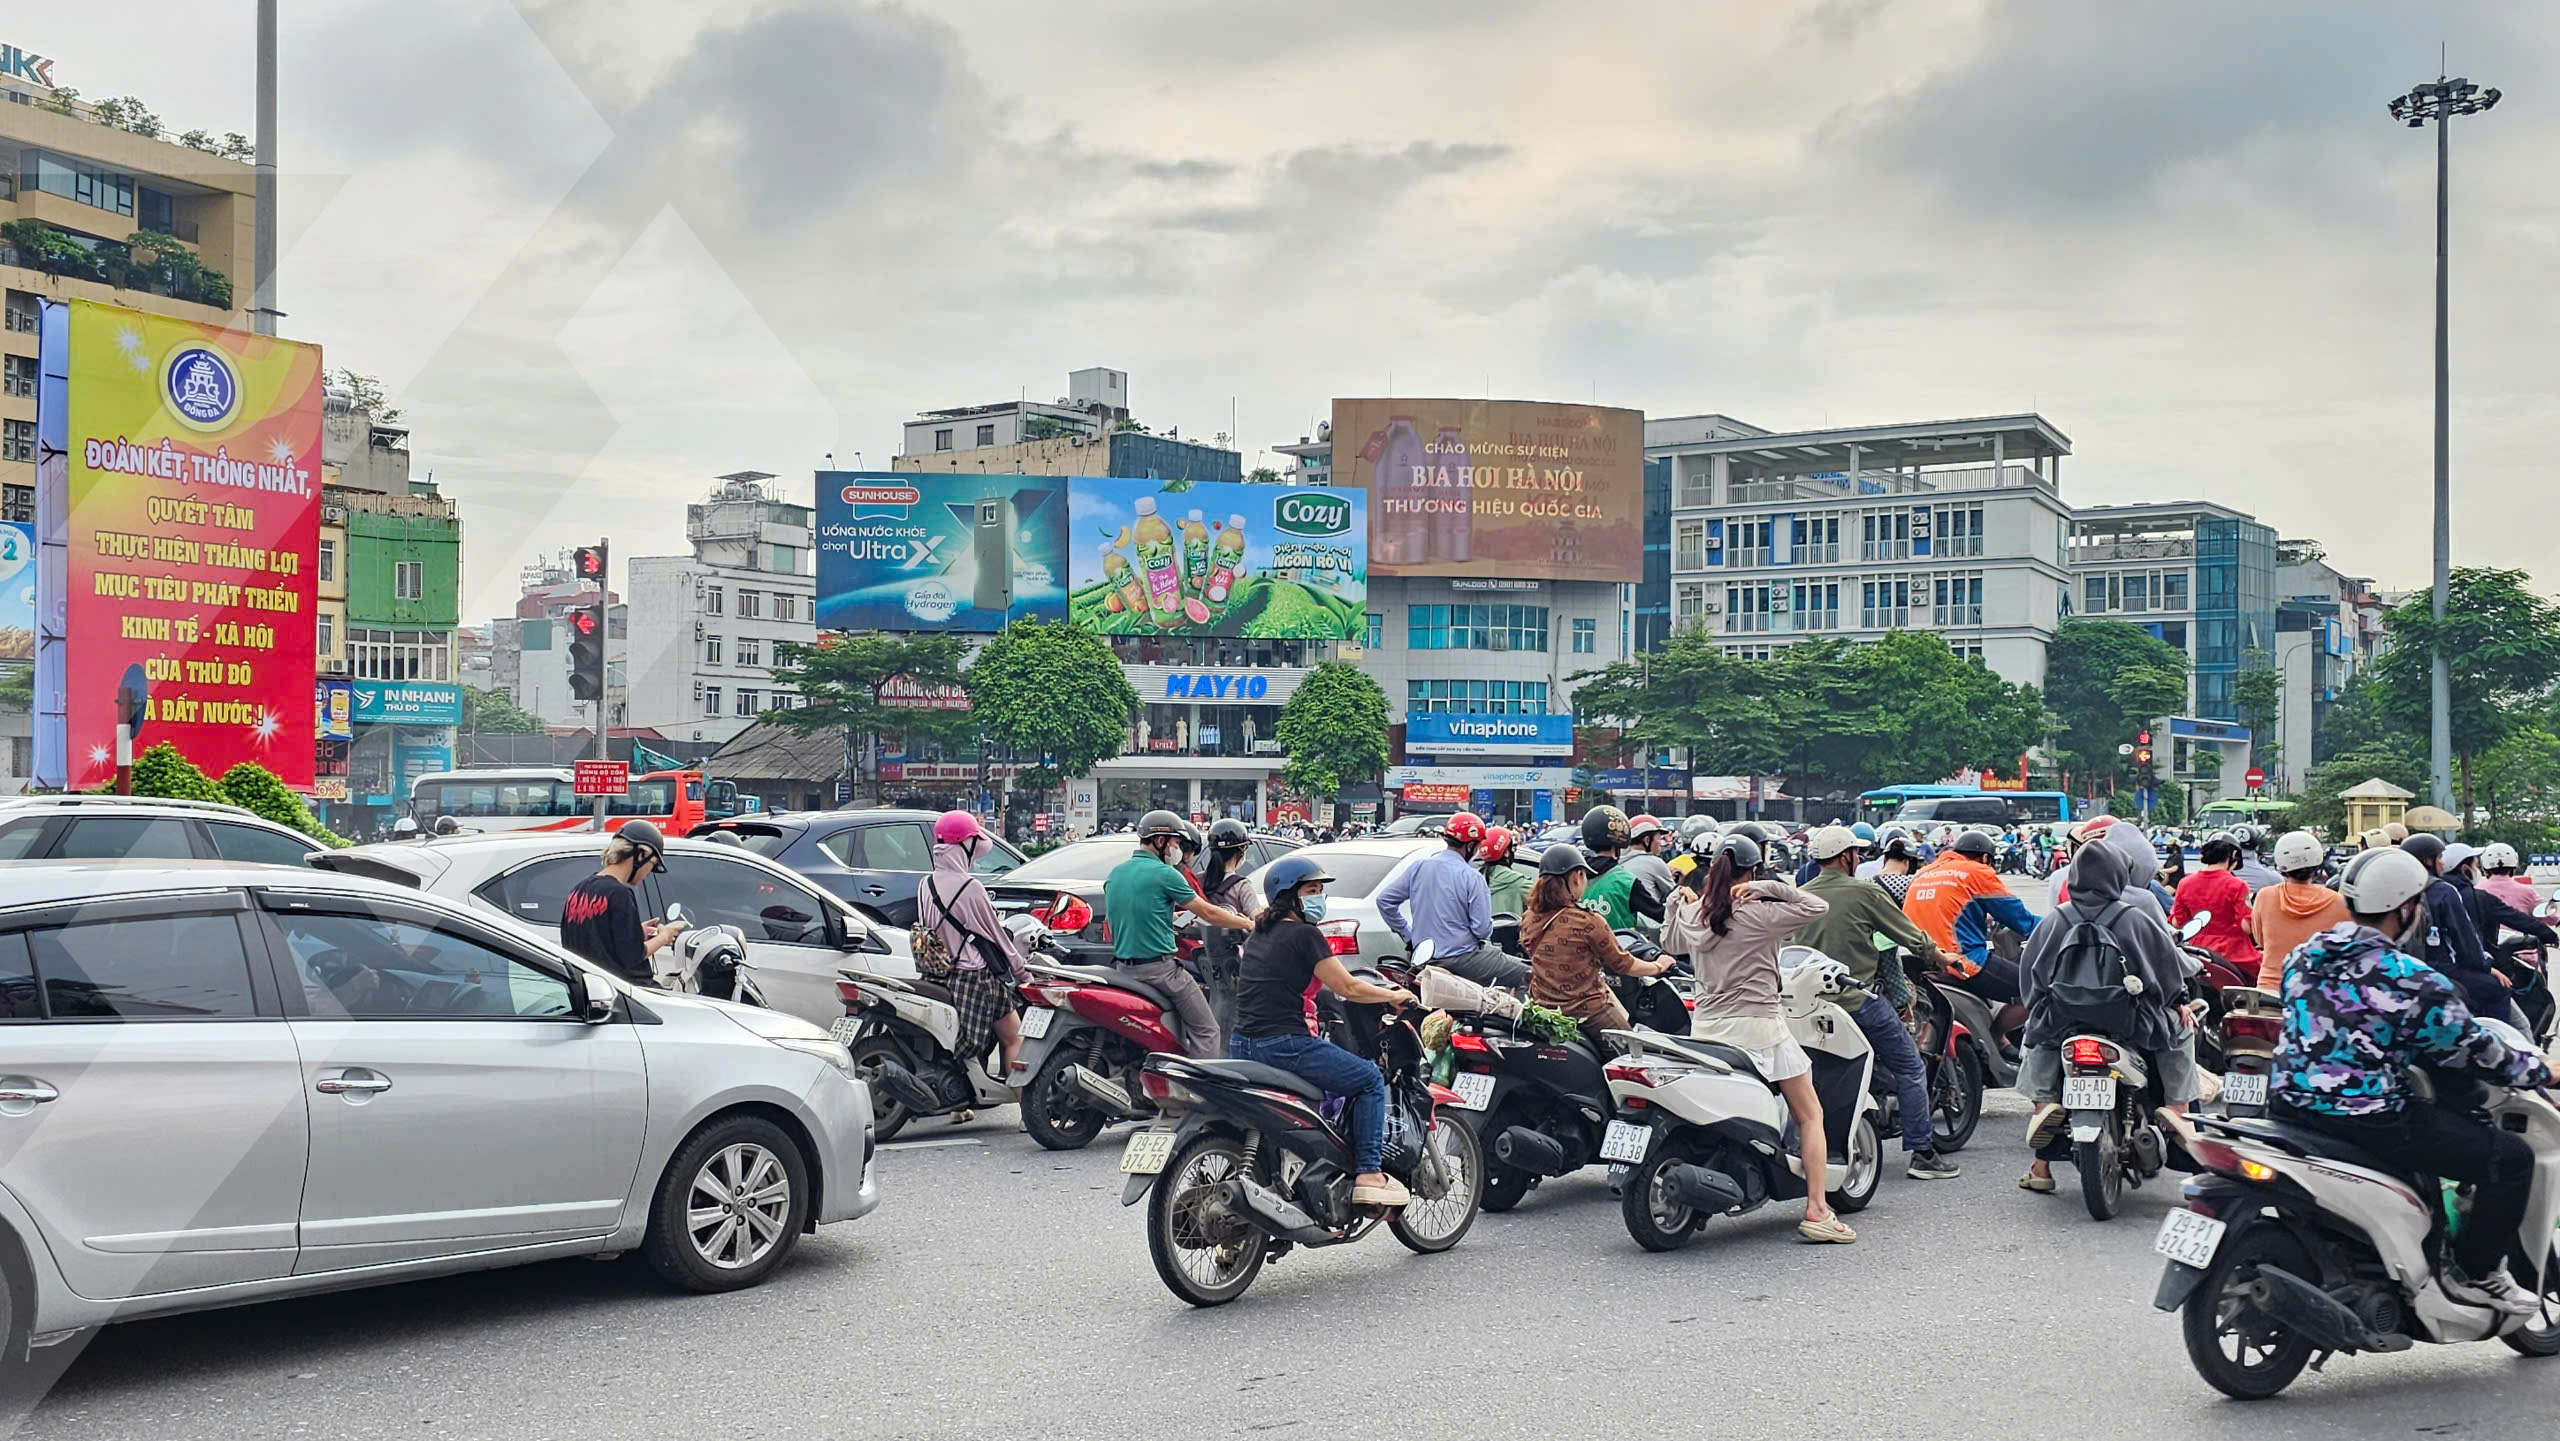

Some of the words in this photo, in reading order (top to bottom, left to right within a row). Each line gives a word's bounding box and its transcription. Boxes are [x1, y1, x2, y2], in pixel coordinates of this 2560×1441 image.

[1425, 442, 1465, 454] CHÀO
[1469, 443, 1513, 455] MỪNG
[1517, 444, 1537, 457] SỰ
[86, 435, 144, 474] ĐOÀN
[147, 437, 188, 484] KẾT,
[191, 445, 255, 488] THỐNG
[258, 456, 312, 499] NHẤT,
[1411, 465, 1451, 488] BIA
[1456, 466, 1501, 489] HƠI
[1505, 463, 1540, 490] HÀ
[1544, 465, 1584, 496] NỘI
[849, 491, 913, 500] SUNHOUSE
[147, 493, 208, 524] QUYẾT
[213, 502, 254, 530] TÂM
[1282, 500, 1343, 530] Cozy
[1384, 498, 1467, 514] THƯƠNG
[1472, 498, 1514, 518] HIỆU
[1519, 499, 1571, 518] QUỐC
[1575, 504, 1603, 519] GIA
[822, 523, 856, 537] UỐNG
[859, 524, 893, 537] NƯỚC
[896, 525, 926, 538] KHỎE
[95, 531, 148, 561] THỰC
[153, 535, 200, 566] HIỆN
[204, 538, 265, 571] THẮNG
[270, 551, 299, 577] LỢI
[822, 541, 847, 552] chọn
[1273, 554, 1313, 569] NGON
[94, 572, 139, 600] MỤC
[144, 575, 188, 602] TIÊU
[192, 581, 241, 607] PHÁT
[245, 582, 298, 613] TRIỂN
[914, 590, 931, 600] Gấp
[906, 600, 956, 610] Hydrogen
[121, 615, 170, 641] KINH
[175, 614, 198, 643] TẾ
[215, 621, 239, 645] XÃ
[244, 623, 274, 652] HỘI
[145, 653, 182, 682] CỦA
[186, 656, 223, 685] THỦ
[227, 660, 252, 685] ĐÔ
[384, 689, 399, 702] IN
[401, 689, 455, 703] NHANH
[144, 693, 156, 721] À
[162, 693, 199, 722] ĐẤT
[203, 699, 253, 725] NƯỚC
[384, 701, 402, 712] THỦ
[1449, 719, 1537, 738] vinaphone
[1078, 793, 1091, 803] 03
[1458, 1075, 1488, 1092] 29-L1
[2072, 1079, 2107, 1092] 90-AD
[2230, 1075, 2260, 1089] 29-D1
[2066, 1093, 2111, 1107] 013.12
[2225, 1089, 2263, 1103] 402.70
[1611, 1124, 1644, 1143] 29-G1
[1132, 1135, 1168, 1151] 29-E2
[1603, 1140, 1643, 1160] 381.38
[1122, 1154, 1164, 1170] 374.75
[2159, 1232, 2209, 1263] 924.29
